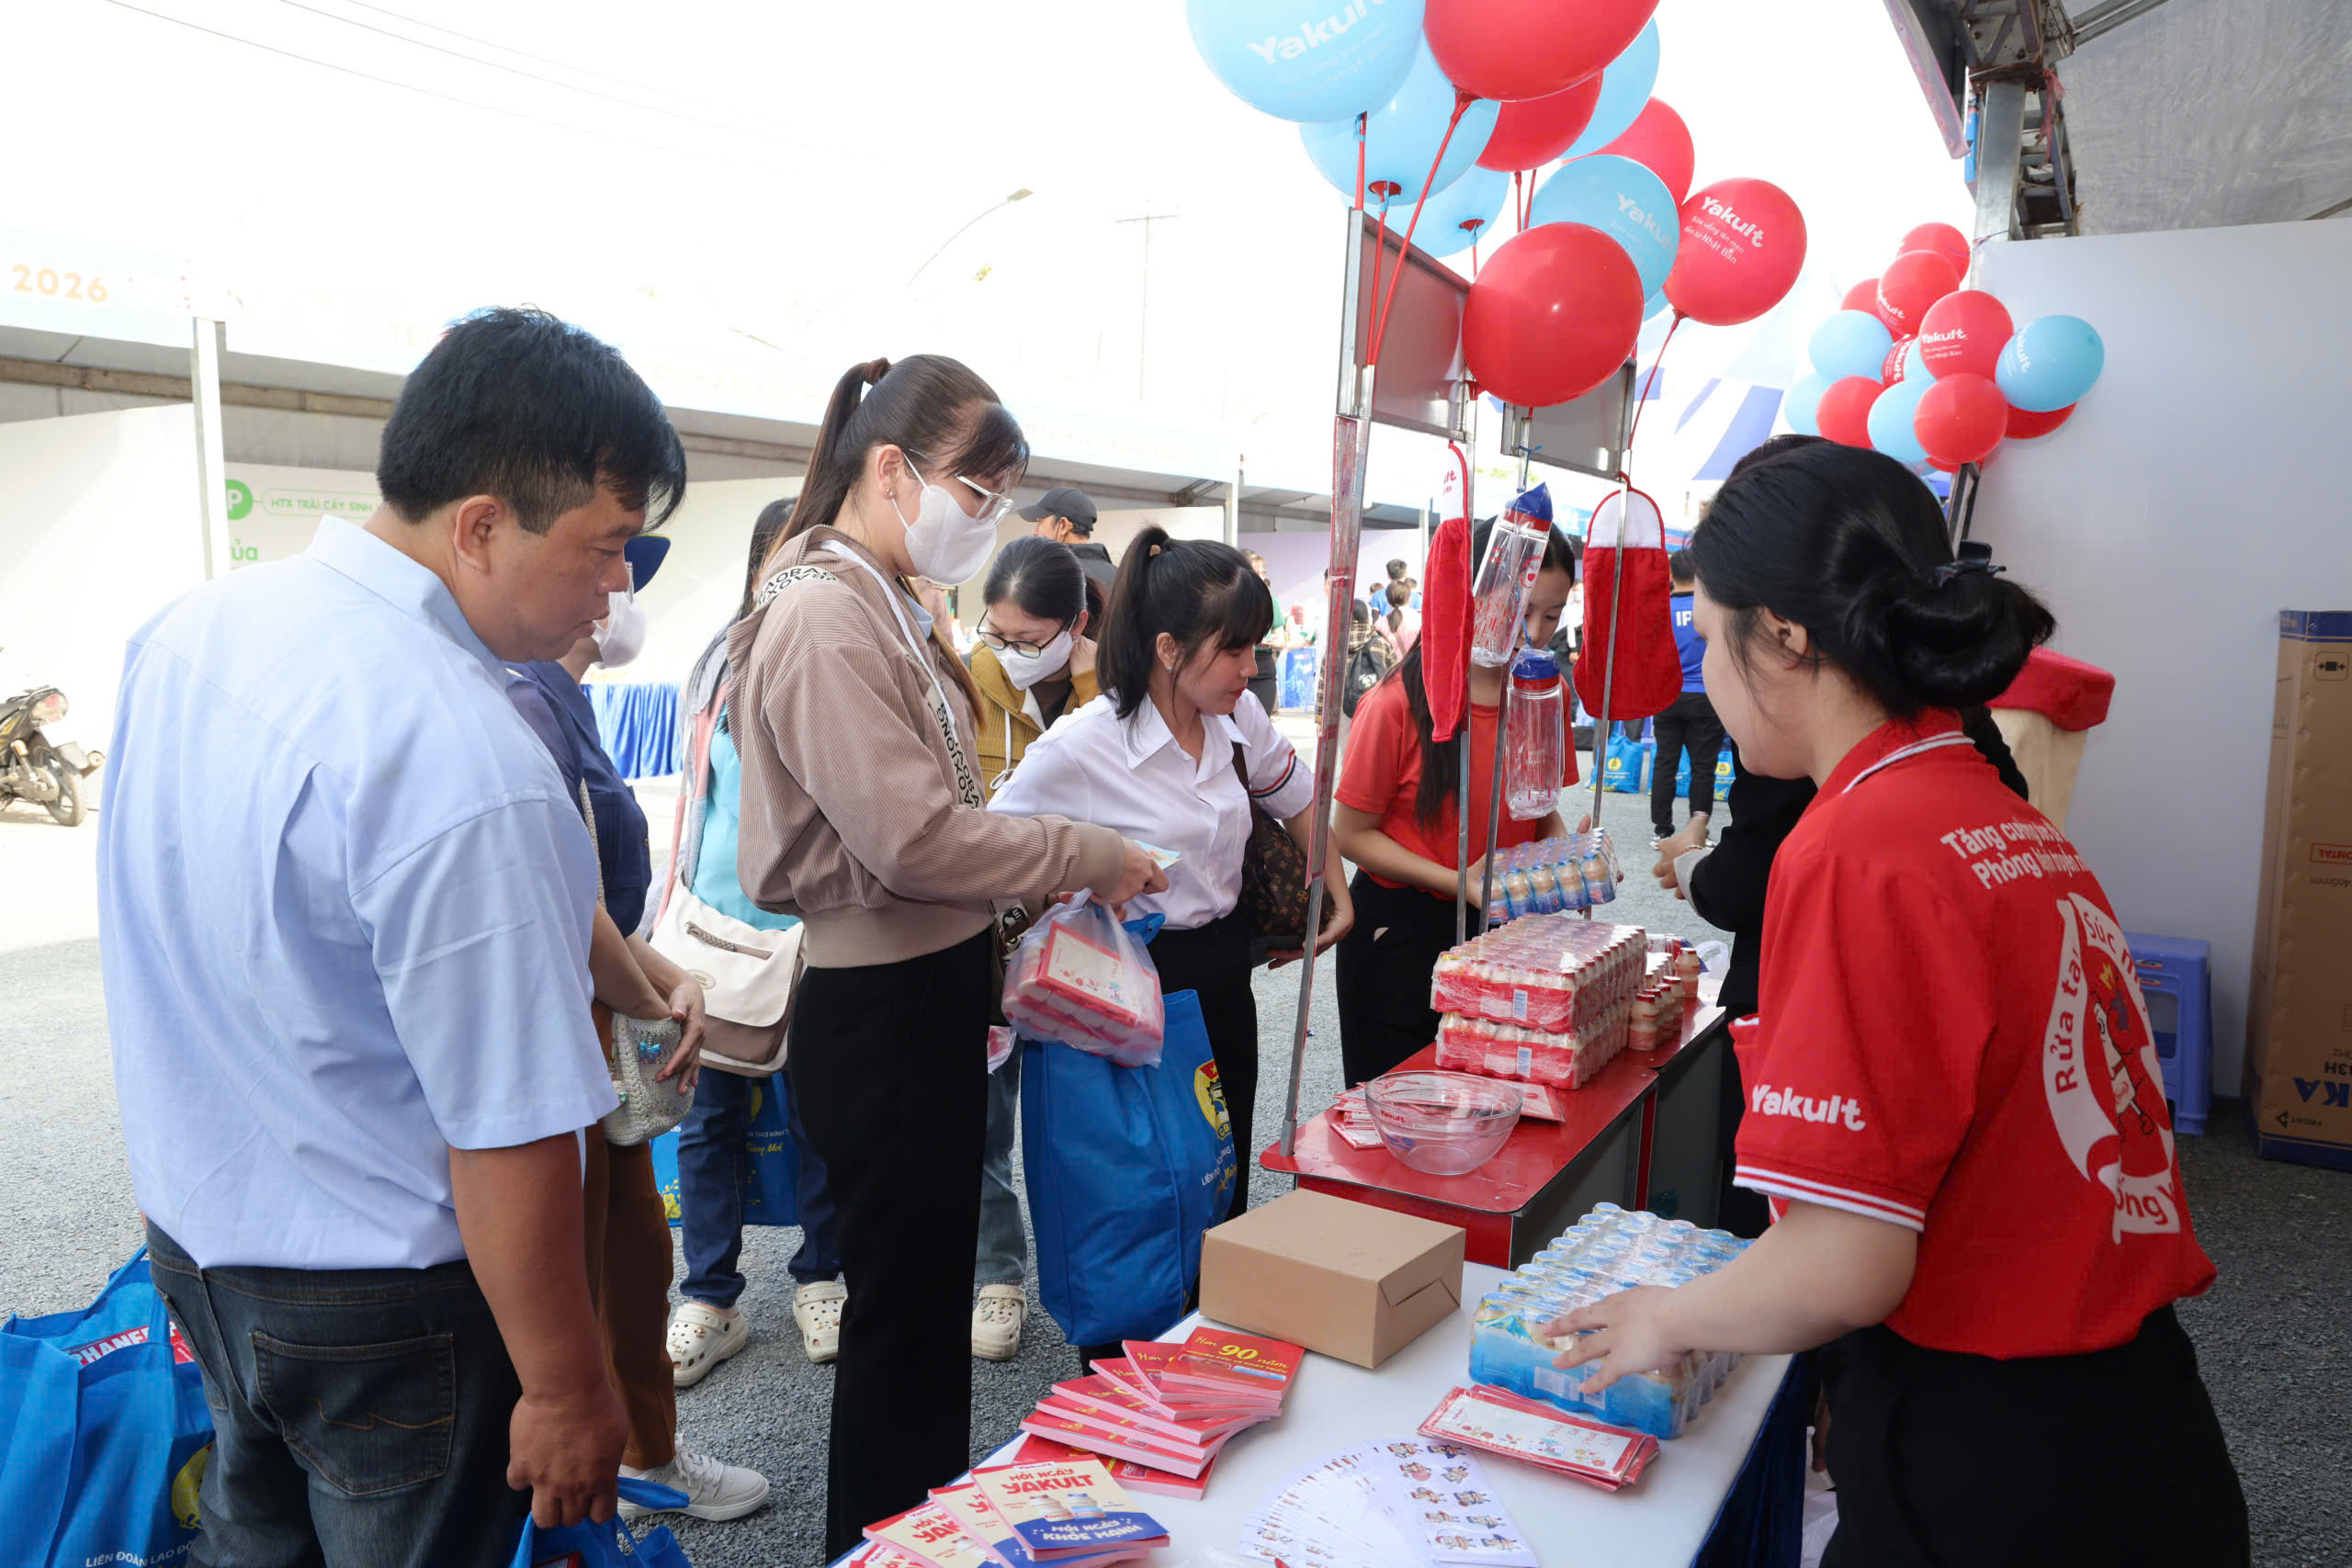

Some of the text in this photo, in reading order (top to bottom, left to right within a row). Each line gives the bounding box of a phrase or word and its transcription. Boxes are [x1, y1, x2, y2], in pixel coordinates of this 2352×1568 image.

[1245, 0, 1386, 65] Yakul
[1701, 196, 1764, 248] Yakult
[1702, 233, 1721, 251] Nhật
[1720, 244, 1737, 265] Bản
[12, 264, 108, 303] 2026
[1921, 328, 1967, 344] Yakult
[271, 498, 293, 508] HTX
[232, 538, 258, 561] ủa
[1675, 610, 1693, 626] IP
[1939, 826, 2007, 860] Tăng
[1971, 852, 2043, 890] Phòng
[2061, 947, 2082, 998] ta
[2050, 1010, 2078, 1094] Rửa
[2324, 1061, 2352, 1076] 3H
[2293, 1077, 2350, 1108] KA
[1379, 1109, 1407, 1123] Yakult
[1752, 1084, 1867, 1132] Yakult
[1218, 1344, 1258, 1360] 90
[1001, 1474, 1096, 1495] YAKULT
[1009, 1467, 1075, 1482] MỖI NGÀY
[911, 1520, 962, 1544] YAK
[1043, 1525, 1144, 1541] KHỎE MẠNH
[1082, 1519, 1120, 1531] NGÀY
[85, 1552, 114, 1568] LIÊN
[116, 1551, 147, 1568] ĐOÀN
